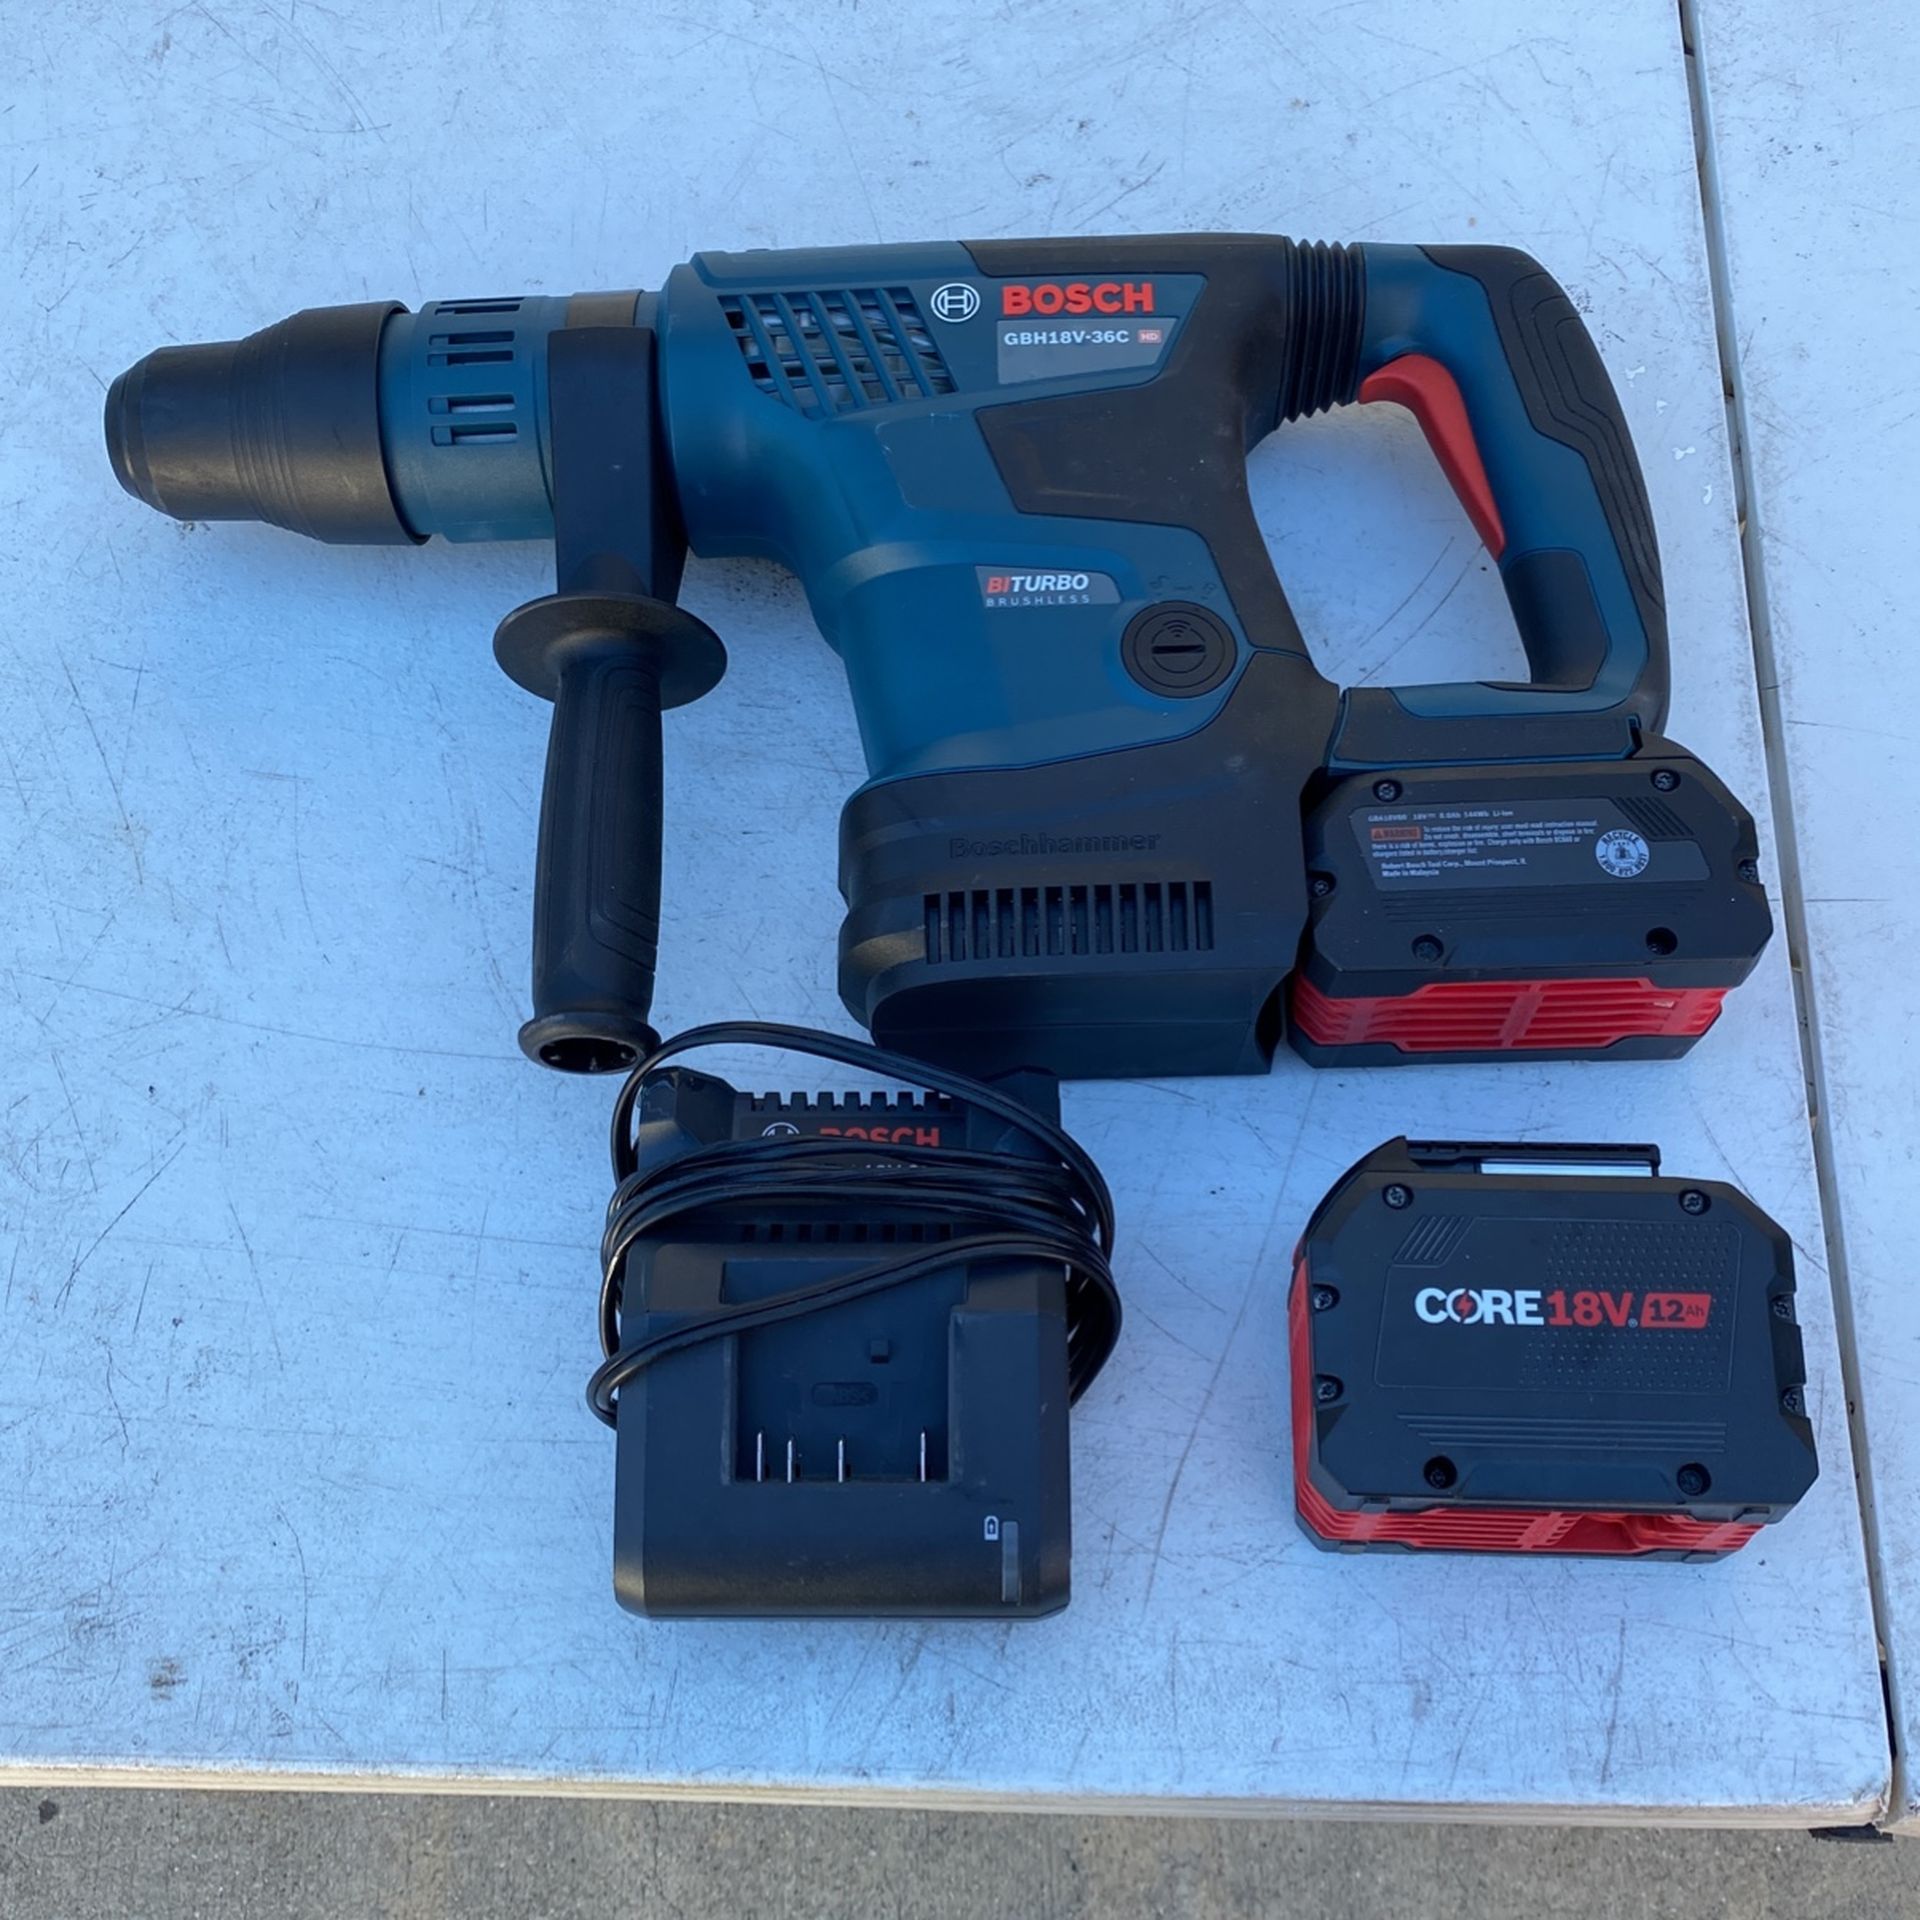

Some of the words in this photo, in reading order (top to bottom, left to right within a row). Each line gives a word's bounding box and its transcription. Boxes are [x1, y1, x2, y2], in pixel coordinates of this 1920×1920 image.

[1003, 283, 1154, 315] BOSCH
[1004, 330, 1130, 345] GBH18V-36C
[1139, 332, 1160, 342] HD
[987, 574, 1089, 593] BITURBO
[985, 594, 1090, 607] BRUSHLESS
[950, 832, 1162, 859] Boschhammer
[1600, 831, 1640, 846] RECYCLE
